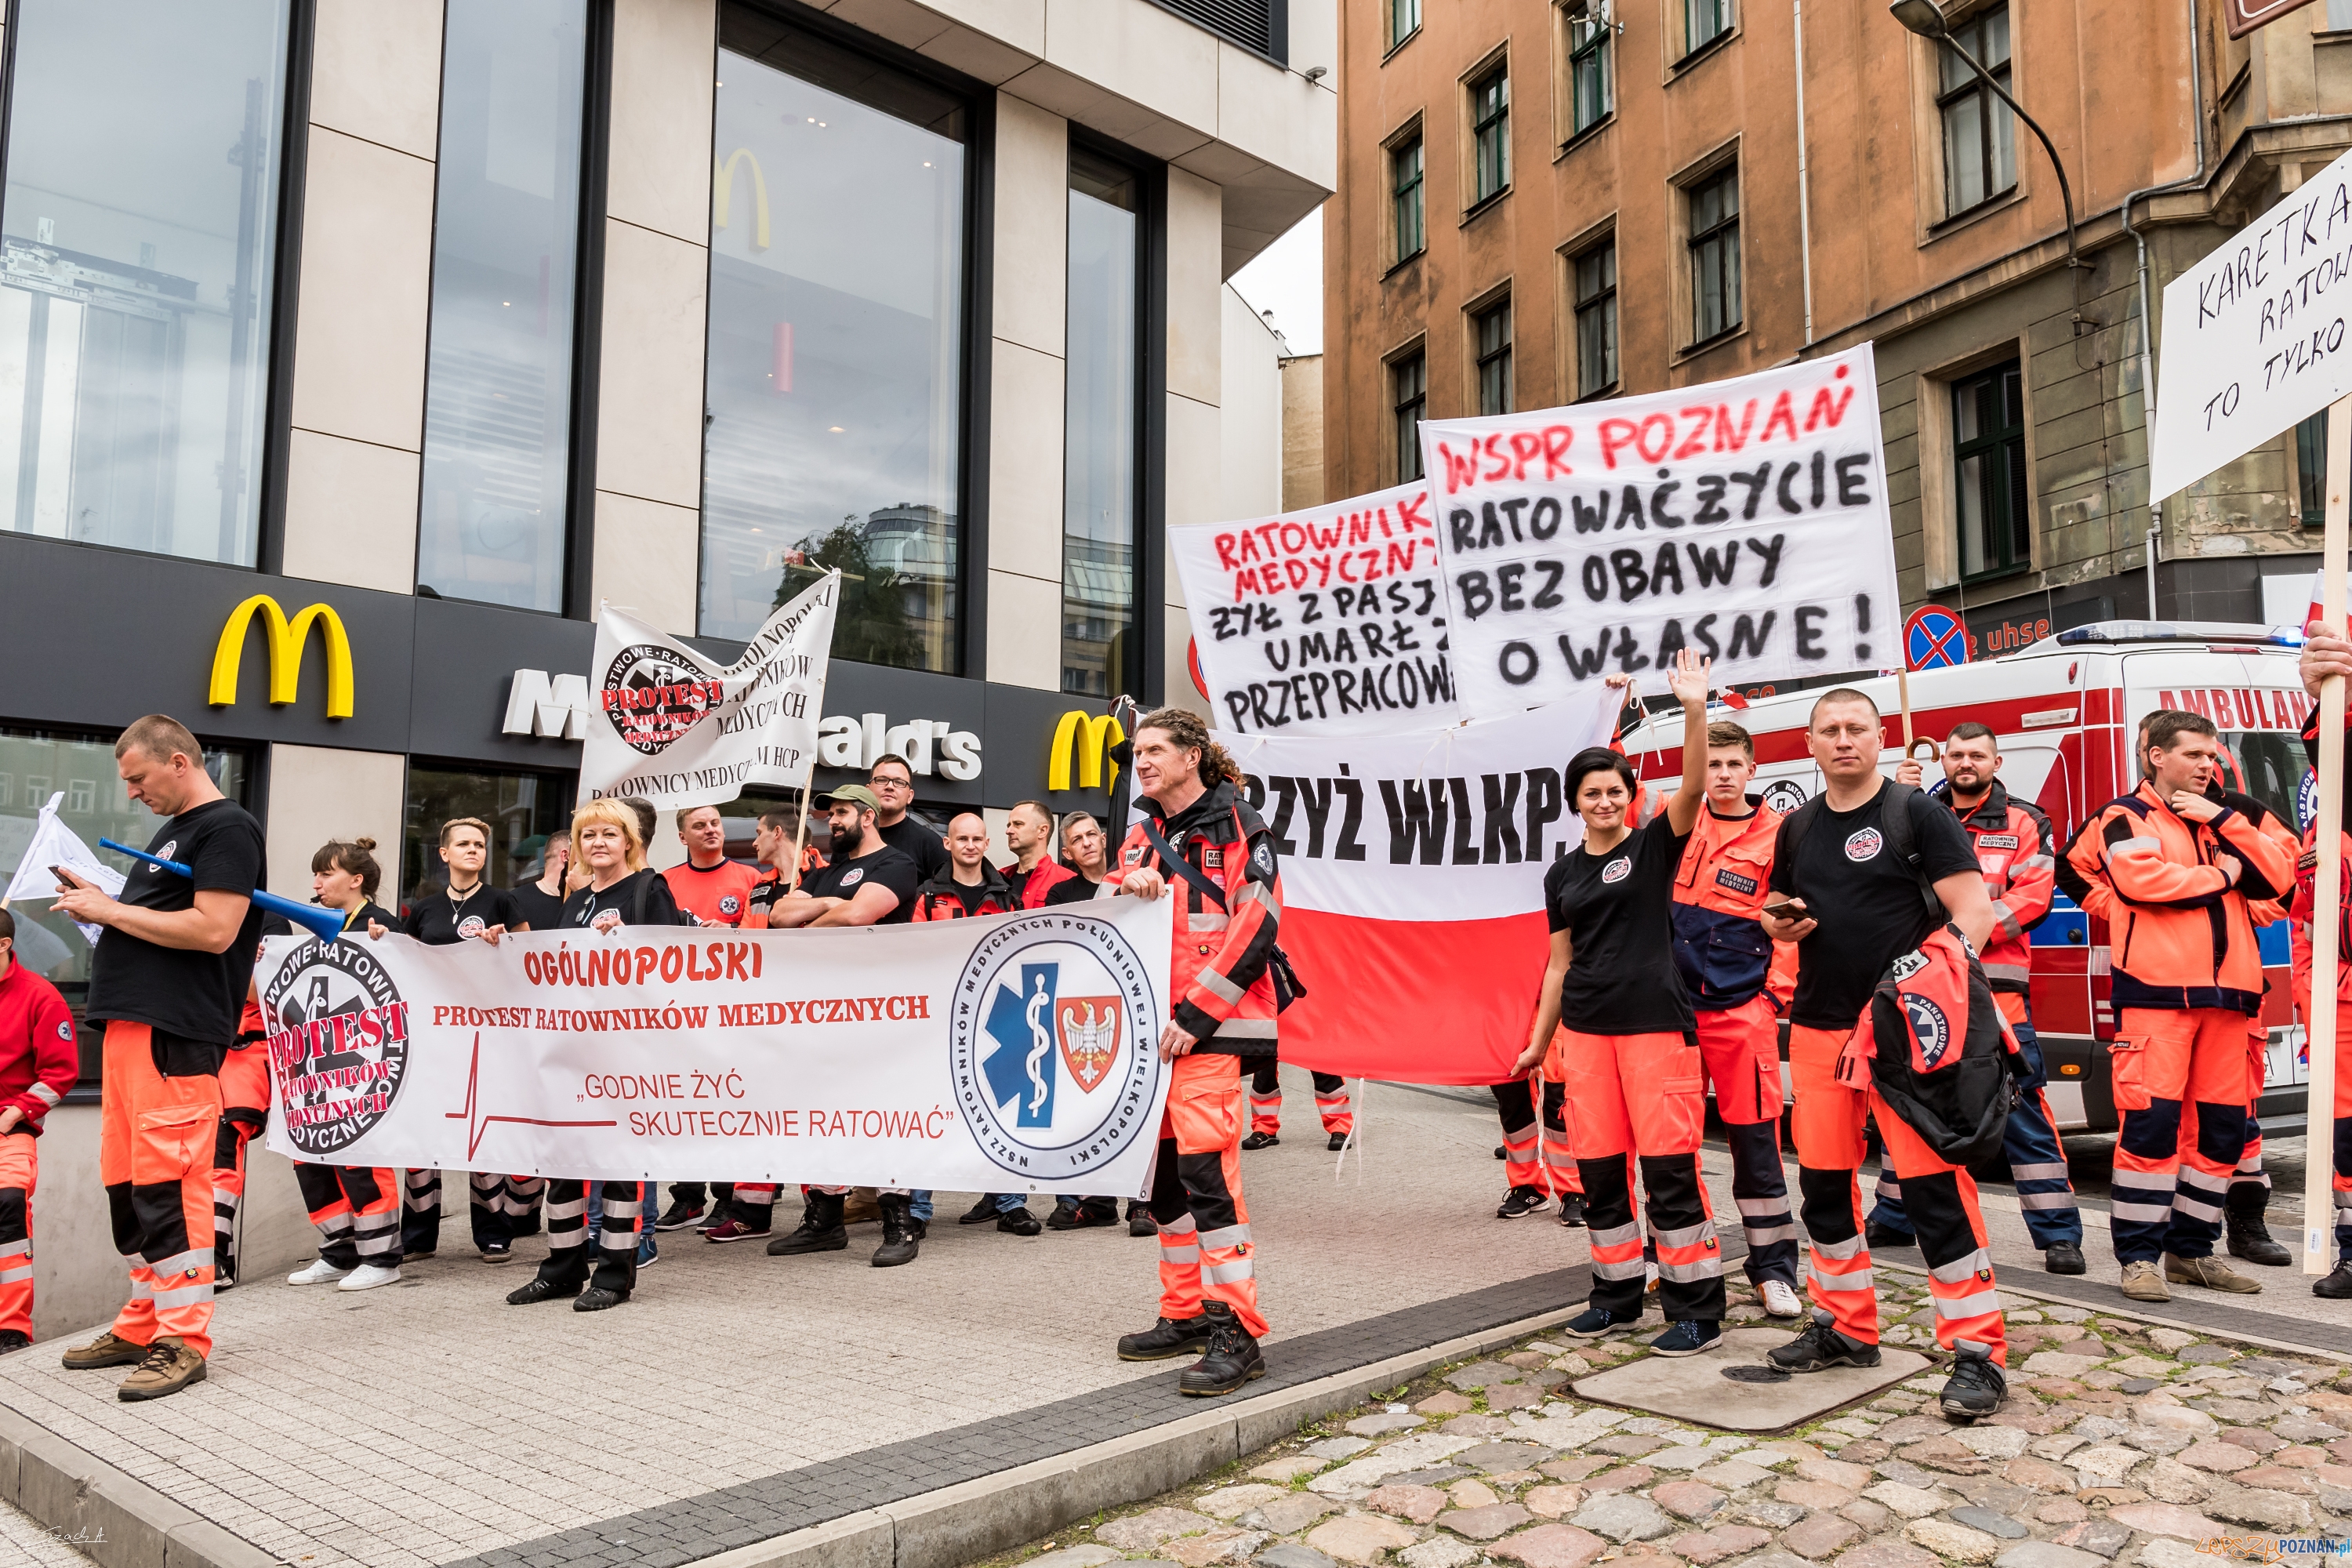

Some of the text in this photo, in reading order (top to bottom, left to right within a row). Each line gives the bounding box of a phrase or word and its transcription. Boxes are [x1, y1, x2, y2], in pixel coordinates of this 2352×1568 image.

[2198, 183, 2351, 329] KARETKA
[2204, 317, 2345, 432] TO TYLKO
[1438, 425, 1575, 495] WSPR
[1213, 490, 1433, 573] RATOWNIK
[1456, 533, 1786, 622] BEZ OBAWY
[1298, 592, 1323, 625] Z
[1332, 578, 1438, 619] PASJ
[1264, 619, 1421, 673] UMARŁ
[1987, 619, 2049, 652] uhse
[607, 646, 655, 722] PASTWOWE
[1498, 641, 1539, 684] O
[601, 679, 724, 712] PROTEST
[1223, 654, 1458, 735] PRZEPRACOW
[773, 746, 800, 769] HCP
[1377, 766, 1567, 866] WLKP.
[1784, 782, 1806, 805] RATOW
[1719, 877, 1753, 893] MEDYCZNY
[1721, 871, 1755, 887] RATOWNIK
[524, 941, 763, 988] OGÓLNOPOLSKI
[267, 1000, 410, 1074] PROTEST
[433, 995, 931, 1033] PROTEST RATOWNIKÓW MEDYCZNYCH
[957, 919, 1149, 1167] NSZZ RATOWNIKÓW MEDYCZNYCH POŁUDNIOWEJ WIELKOPOLSKI
[693, 1068, 746, 1099] ŻYĆ
[628, 1109, 799, 1138] SKUTECZNIE
